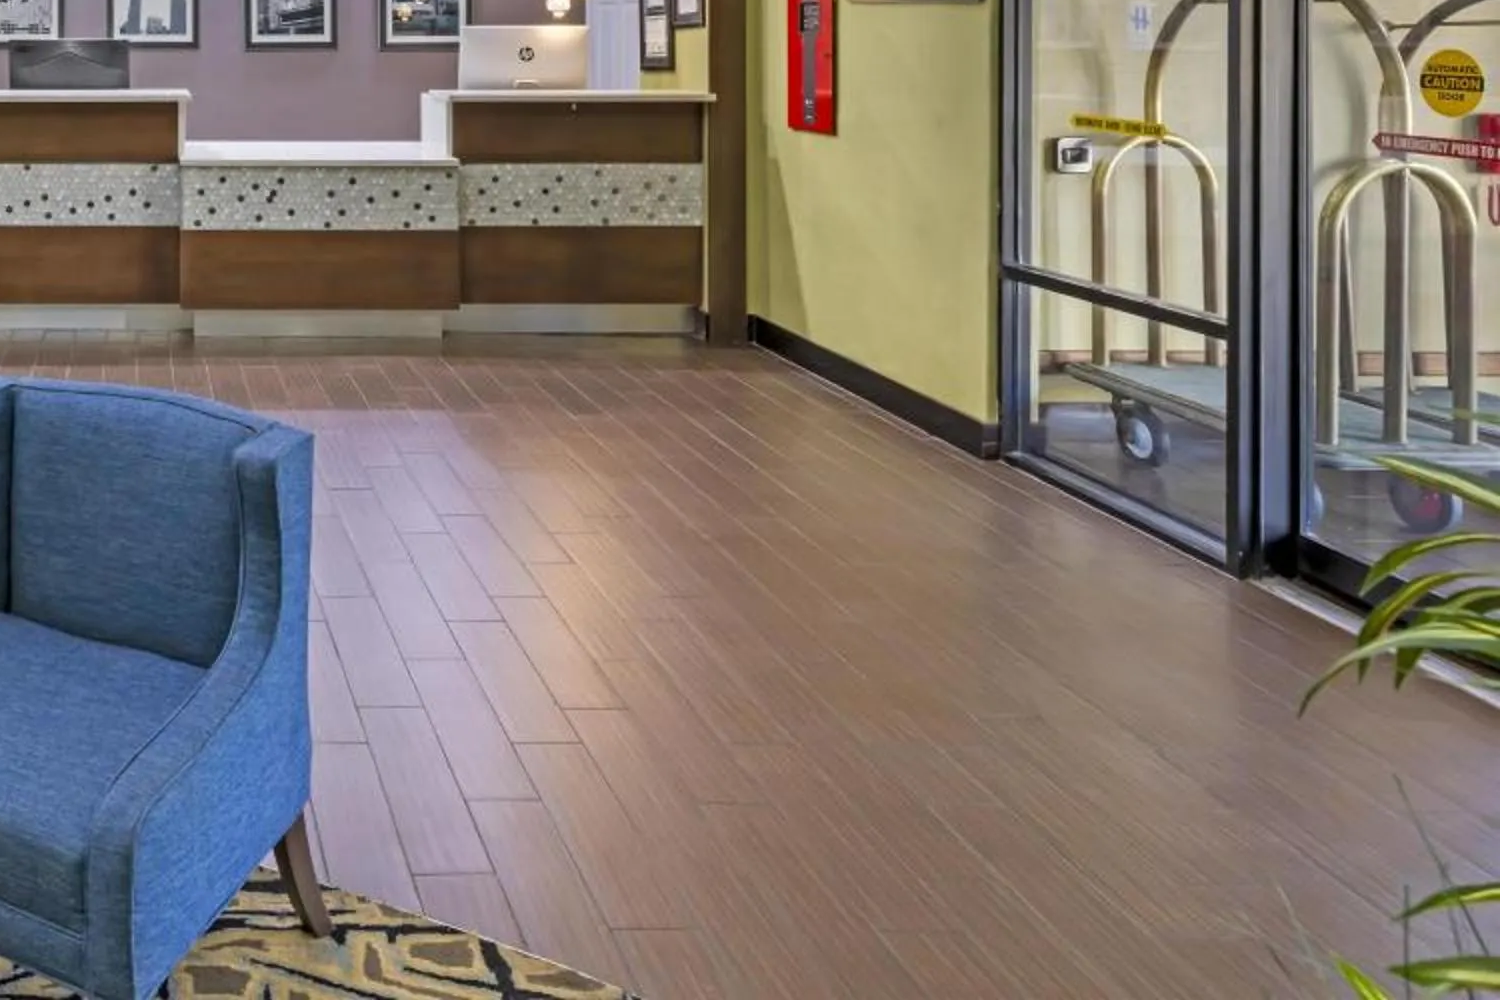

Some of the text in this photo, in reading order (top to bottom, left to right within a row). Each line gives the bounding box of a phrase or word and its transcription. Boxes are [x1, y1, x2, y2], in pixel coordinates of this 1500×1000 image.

[1427, 63, 1479, 74] AUTOMATIC
[1423, 78, 1482, 90] CAUTION
[1393, 136, 1448, 154] EMERGENCY
[1451, 142, 1479, 157] PUSH
[1481, 145, 1496, 159] TO
